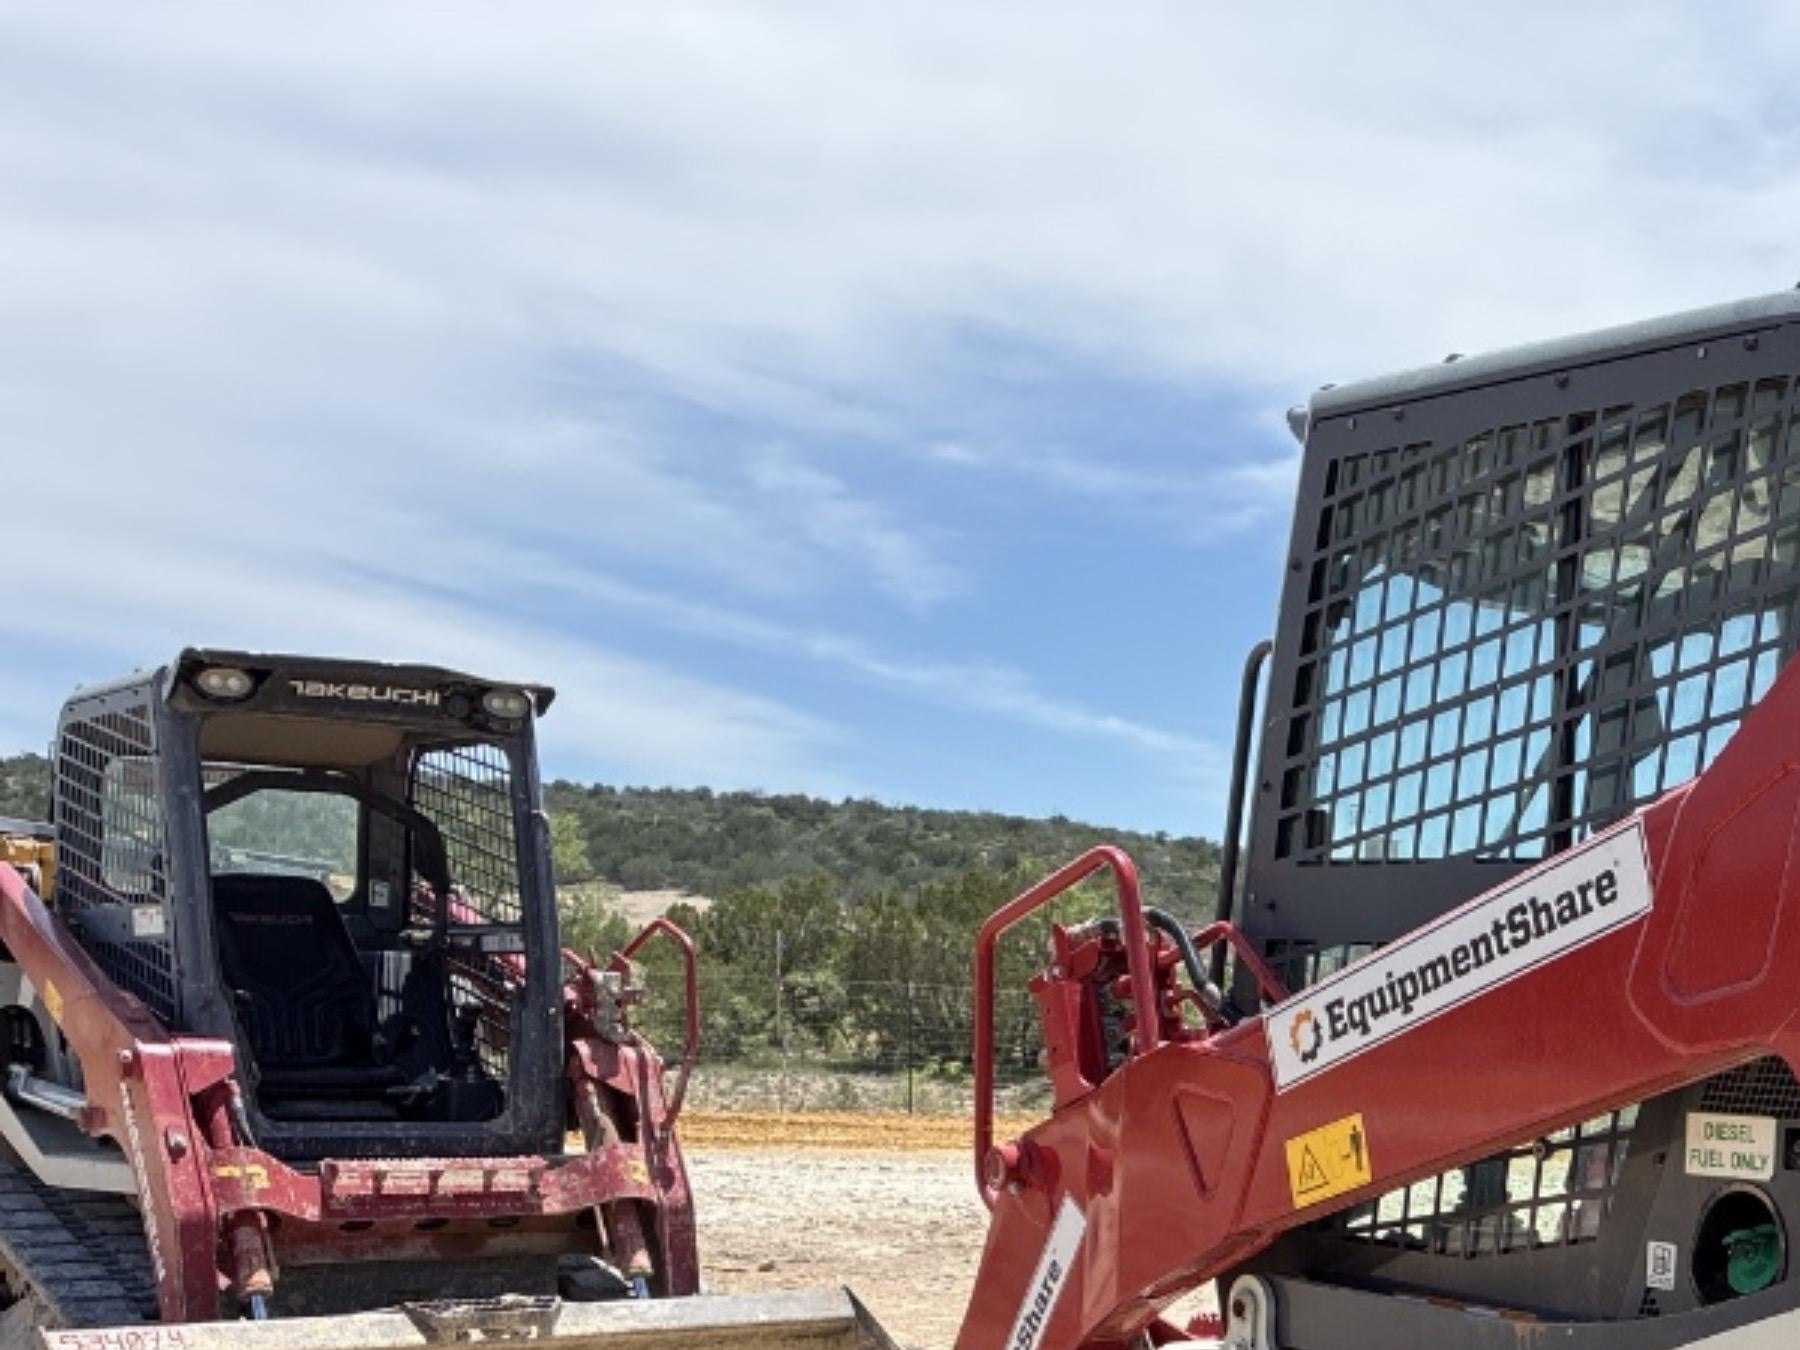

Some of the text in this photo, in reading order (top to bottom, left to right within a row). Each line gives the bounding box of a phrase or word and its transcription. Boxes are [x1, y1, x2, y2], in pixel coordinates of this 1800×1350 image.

[1324, 866, 1618, 1040] EquipmentShare
[1703, 1121, 1756, 1144] DIESEL
[1688, 1148, 1771, 1171] FUEL ONLY
